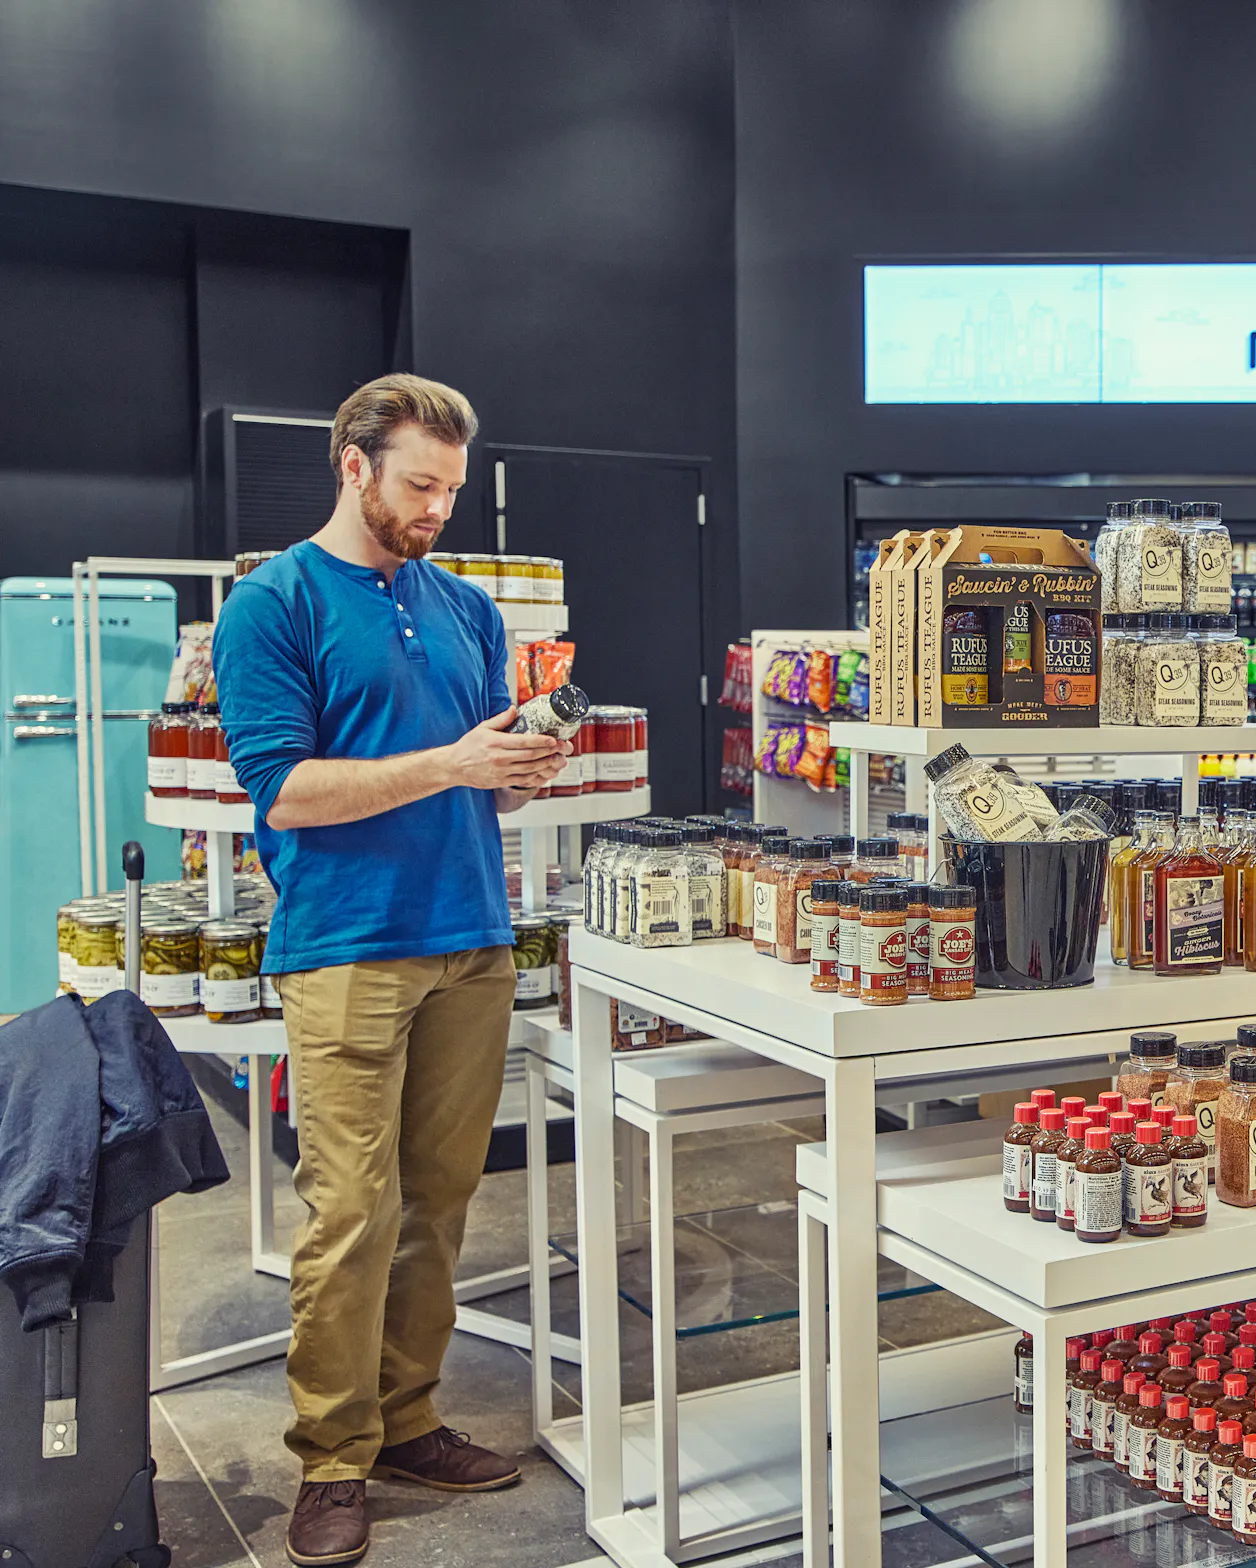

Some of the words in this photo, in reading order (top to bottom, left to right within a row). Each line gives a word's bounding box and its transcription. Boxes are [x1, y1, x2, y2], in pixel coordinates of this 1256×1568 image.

[1146, 550, 1166, 569] Q39
[1201, 552, 1221, 571] Q39
[1019, 580, 1030, 592] &
[1156, 584, 1178, 592] SEASONING
[1053, 594, 1071, 603] BBQ
[1074, 595, 1092, 603] KIT
[875, 580, 883, 653] TEAGUE
[924, 575, 933, 652] TEAGUE
[951, 638, 988, 653] RUFUS
[952, 654, 988, 666] TEAGUE
[1047, 655, 1091, 667] EAGUE
[1160, 664, 1184, 683] Q39
[1211, 666, 1232, 684] Q39
[924, 658, 932, 718] RUFUS
[1172, 698, 1195, 706] SEASONING
[973, 791, 998, 814] Q39
[992, 826, 1007, 838] STEAK
[1004, 812, 1028, 831] SEASONING
[943, 939, 973, 949] JOE'S
[1174, 940, 1220, 956] Hibiscus
[1184, 935, 1211, 946] GINGER
[884, 944, 906, 954] JOE'
